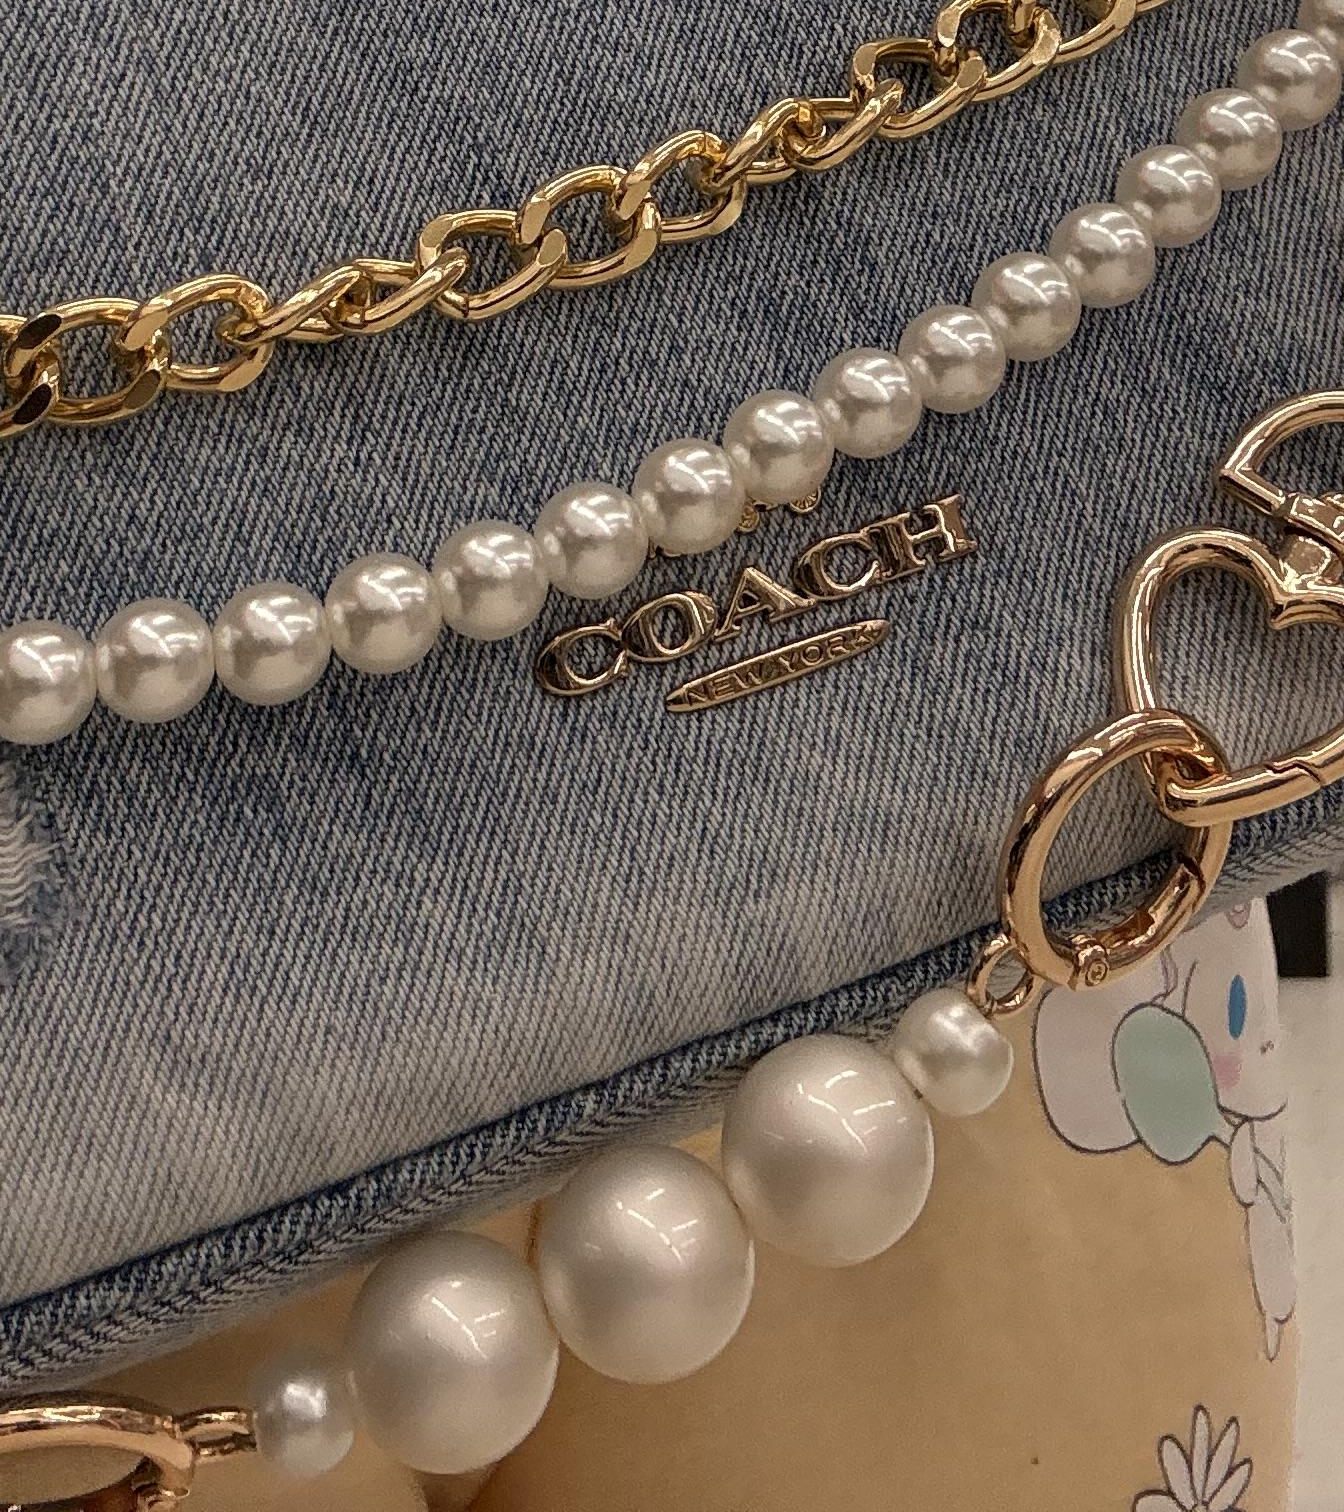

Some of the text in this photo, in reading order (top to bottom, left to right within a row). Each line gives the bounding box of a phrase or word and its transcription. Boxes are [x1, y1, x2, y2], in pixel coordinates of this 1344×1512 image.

[534, 493, 978, 696] COACH
[681, 621, 882, 706] NEW YORK
